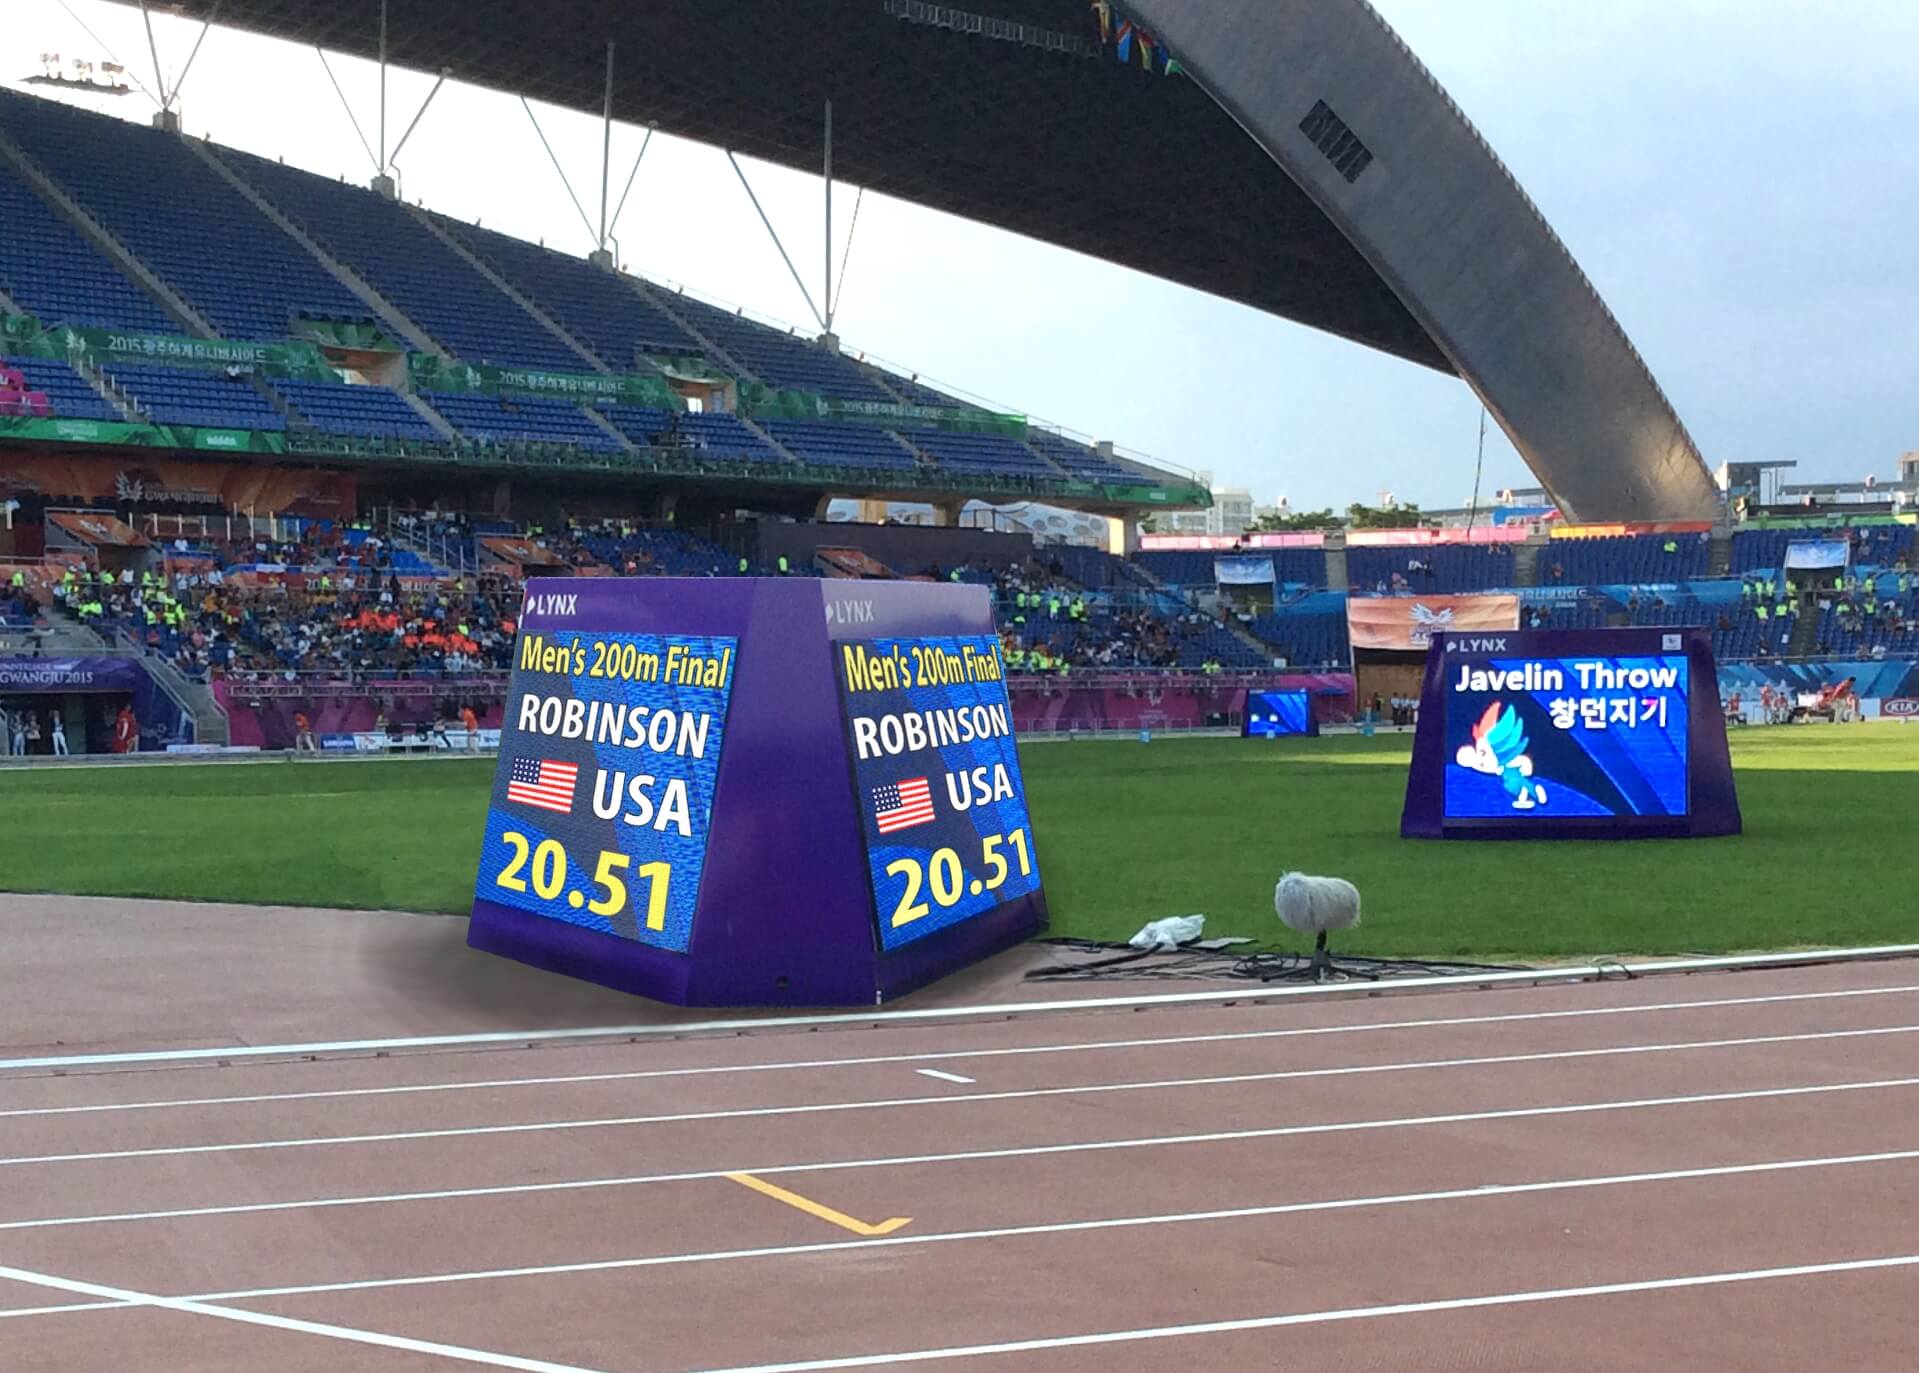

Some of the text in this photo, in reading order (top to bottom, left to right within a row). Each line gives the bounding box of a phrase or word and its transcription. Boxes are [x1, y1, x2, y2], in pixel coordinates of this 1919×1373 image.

[536, 594, 578, 616] LYNX
[835, 599, 874, 624] LYNX
[520, 635, 731, 688] Men's 200m Final
[843, 644, 1001, 693] Men's 200m Final
[1459, 638, 1507, 653] LYNX
[1455, 662, 1678, 693] Javelin Throw
[518, 693, 711, 759] ROBINSON
[853, 703, 1010, 760] ROBINSON
[1549, 696, 1667, 729] 창던지기
[592, 769, 692, 837] USA
[945, 763, 1014, 812] USA
[496, 831, 671, 932] 20.51
[886, 828, 1031, 929] 20.51
